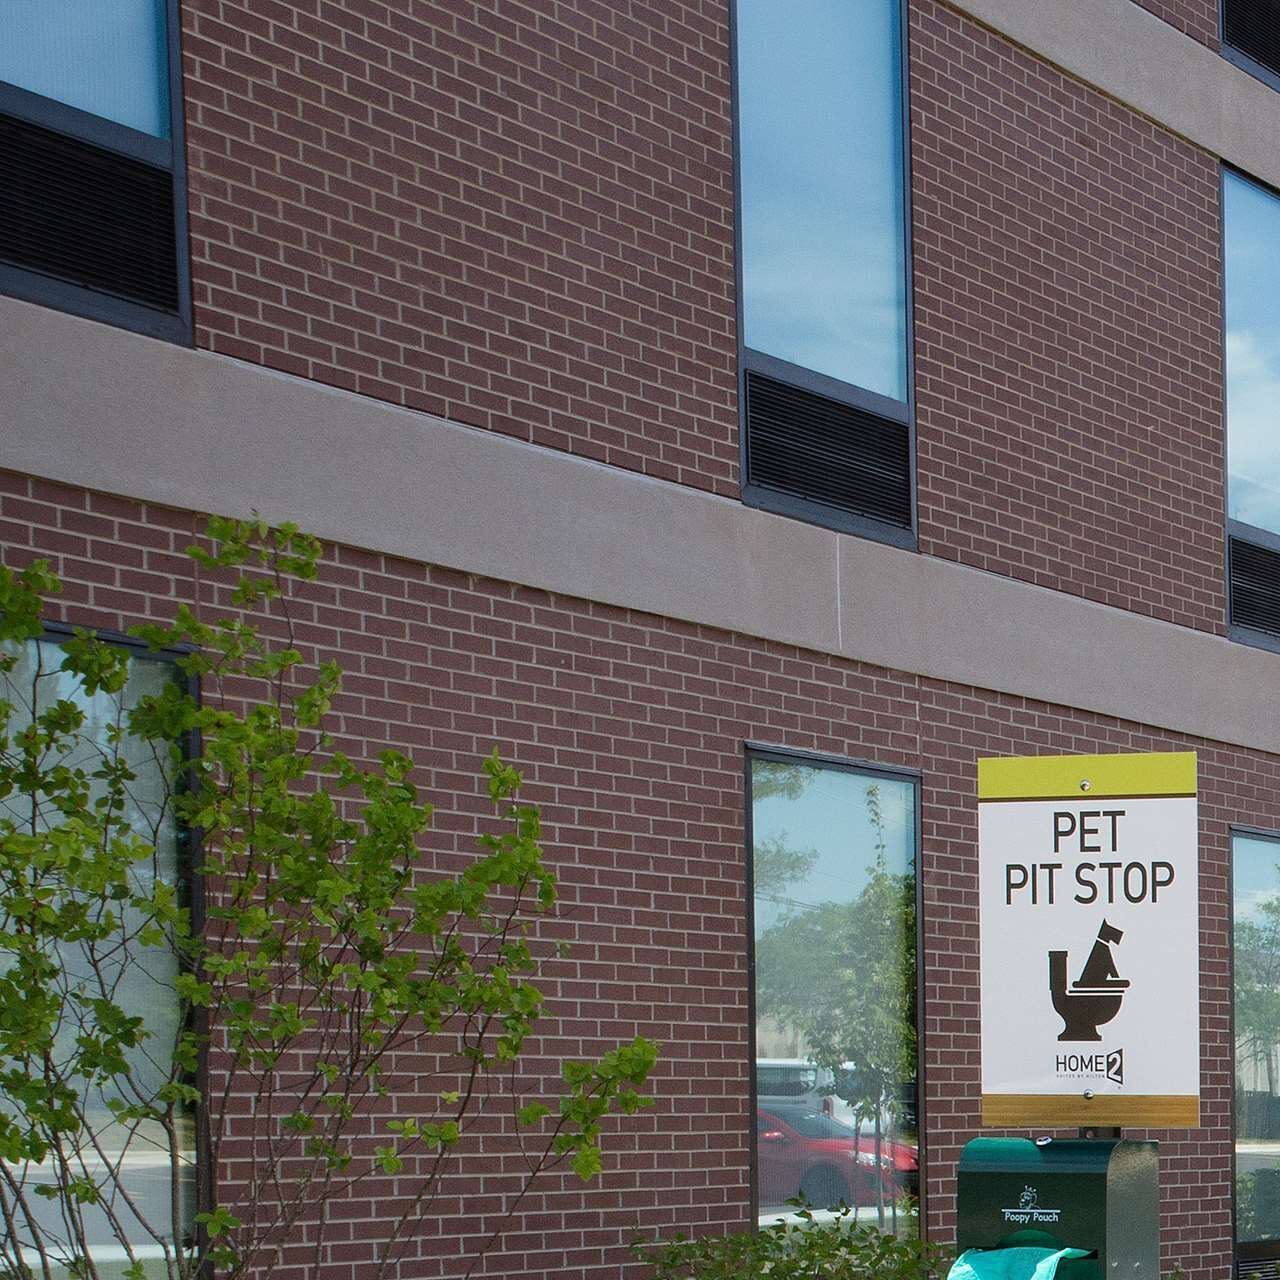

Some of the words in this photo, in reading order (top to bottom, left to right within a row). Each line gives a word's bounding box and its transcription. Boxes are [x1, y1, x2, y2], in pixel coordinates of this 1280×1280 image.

[1053, 811, 1126, 853] PET
[1006, 863, 1062, 905] PIT
[1074, 861, 1175, 904] STOP
[1005, 1212, 1030, 1224] Poopy
[1033, 1212, 1059, 1222] Pouch
